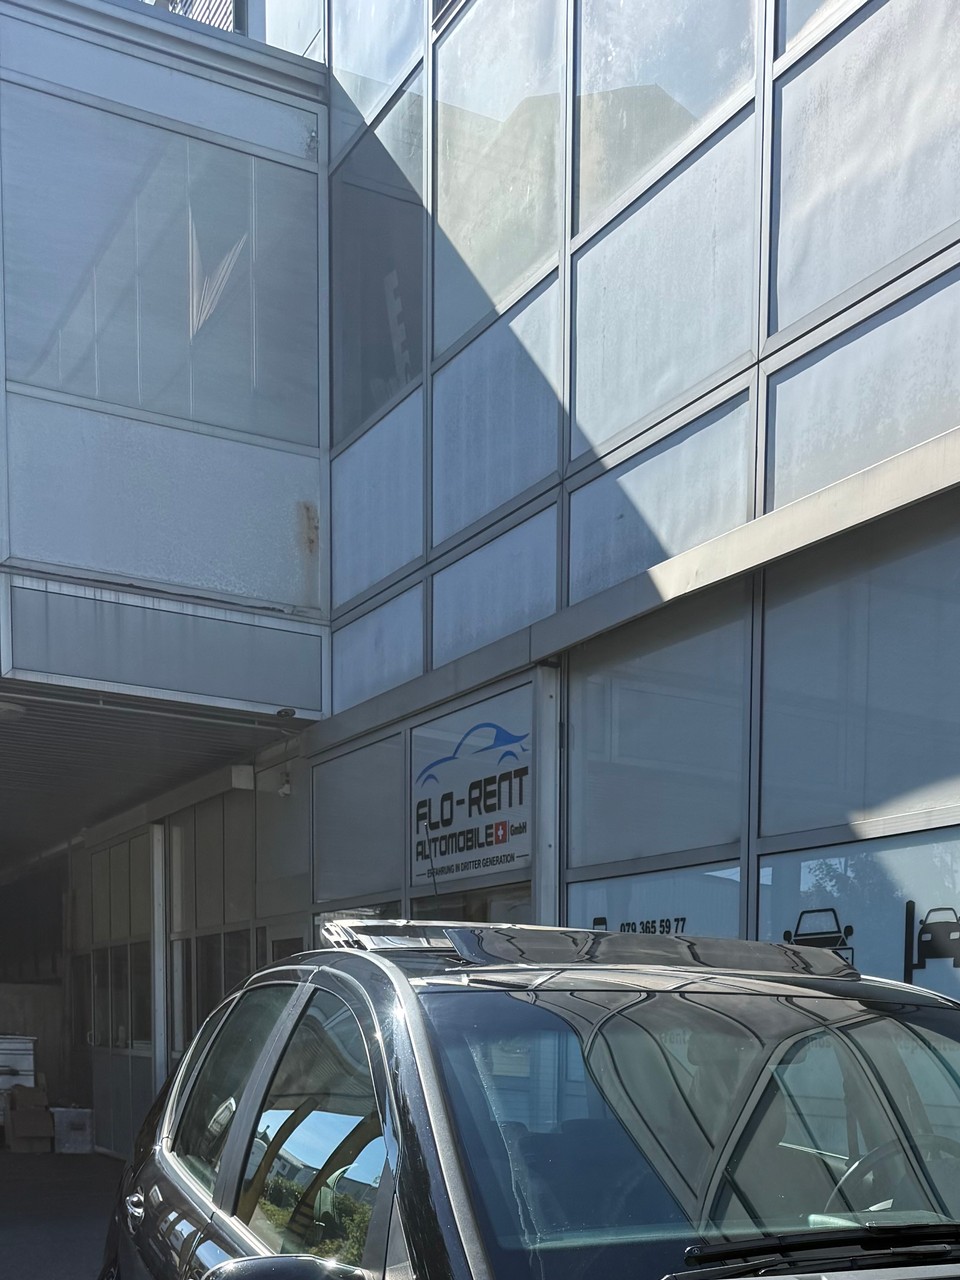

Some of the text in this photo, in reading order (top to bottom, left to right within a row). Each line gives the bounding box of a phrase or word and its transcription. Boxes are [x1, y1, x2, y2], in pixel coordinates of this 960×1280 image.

[416, 766, 528, 834] FLO-RENT
[416, 821, 527, 861] AUTOMOBILE GmbH
[427, 853, 515, 878] ERFAHRUNG IN DRITTER GENERATION
[620, 917, 686, 934] 079 365 59 77
